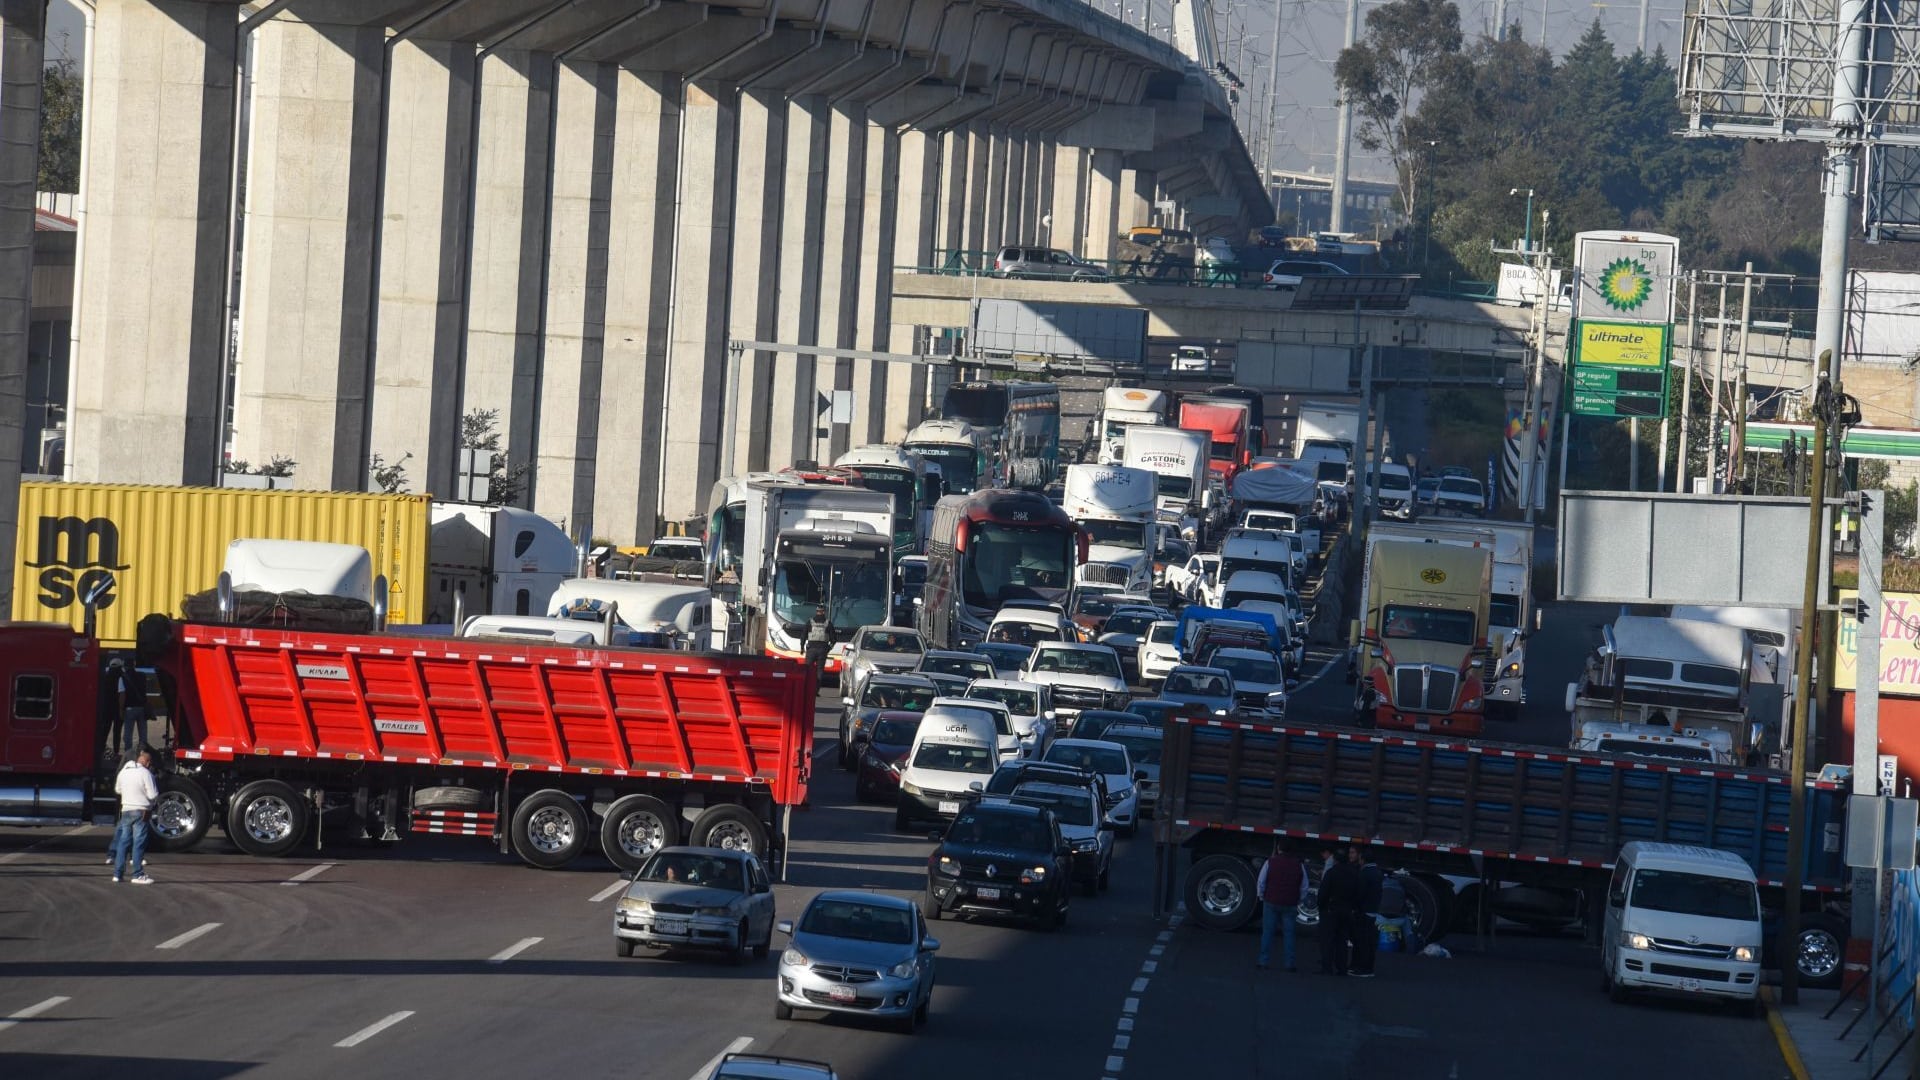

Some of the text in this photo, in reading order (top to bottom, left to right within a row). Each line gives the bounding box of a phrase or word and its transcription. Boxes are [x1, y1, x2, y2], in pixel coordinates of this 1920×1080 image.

[1641, 247, 1656, 261] bp
[1589, 332, 1643, 344] ultimate
[1588, 372, 1611, 380] regular
[1141, 455, 1186, 466] CASTORES
[381, 722, 419, 731] TRAILERS
